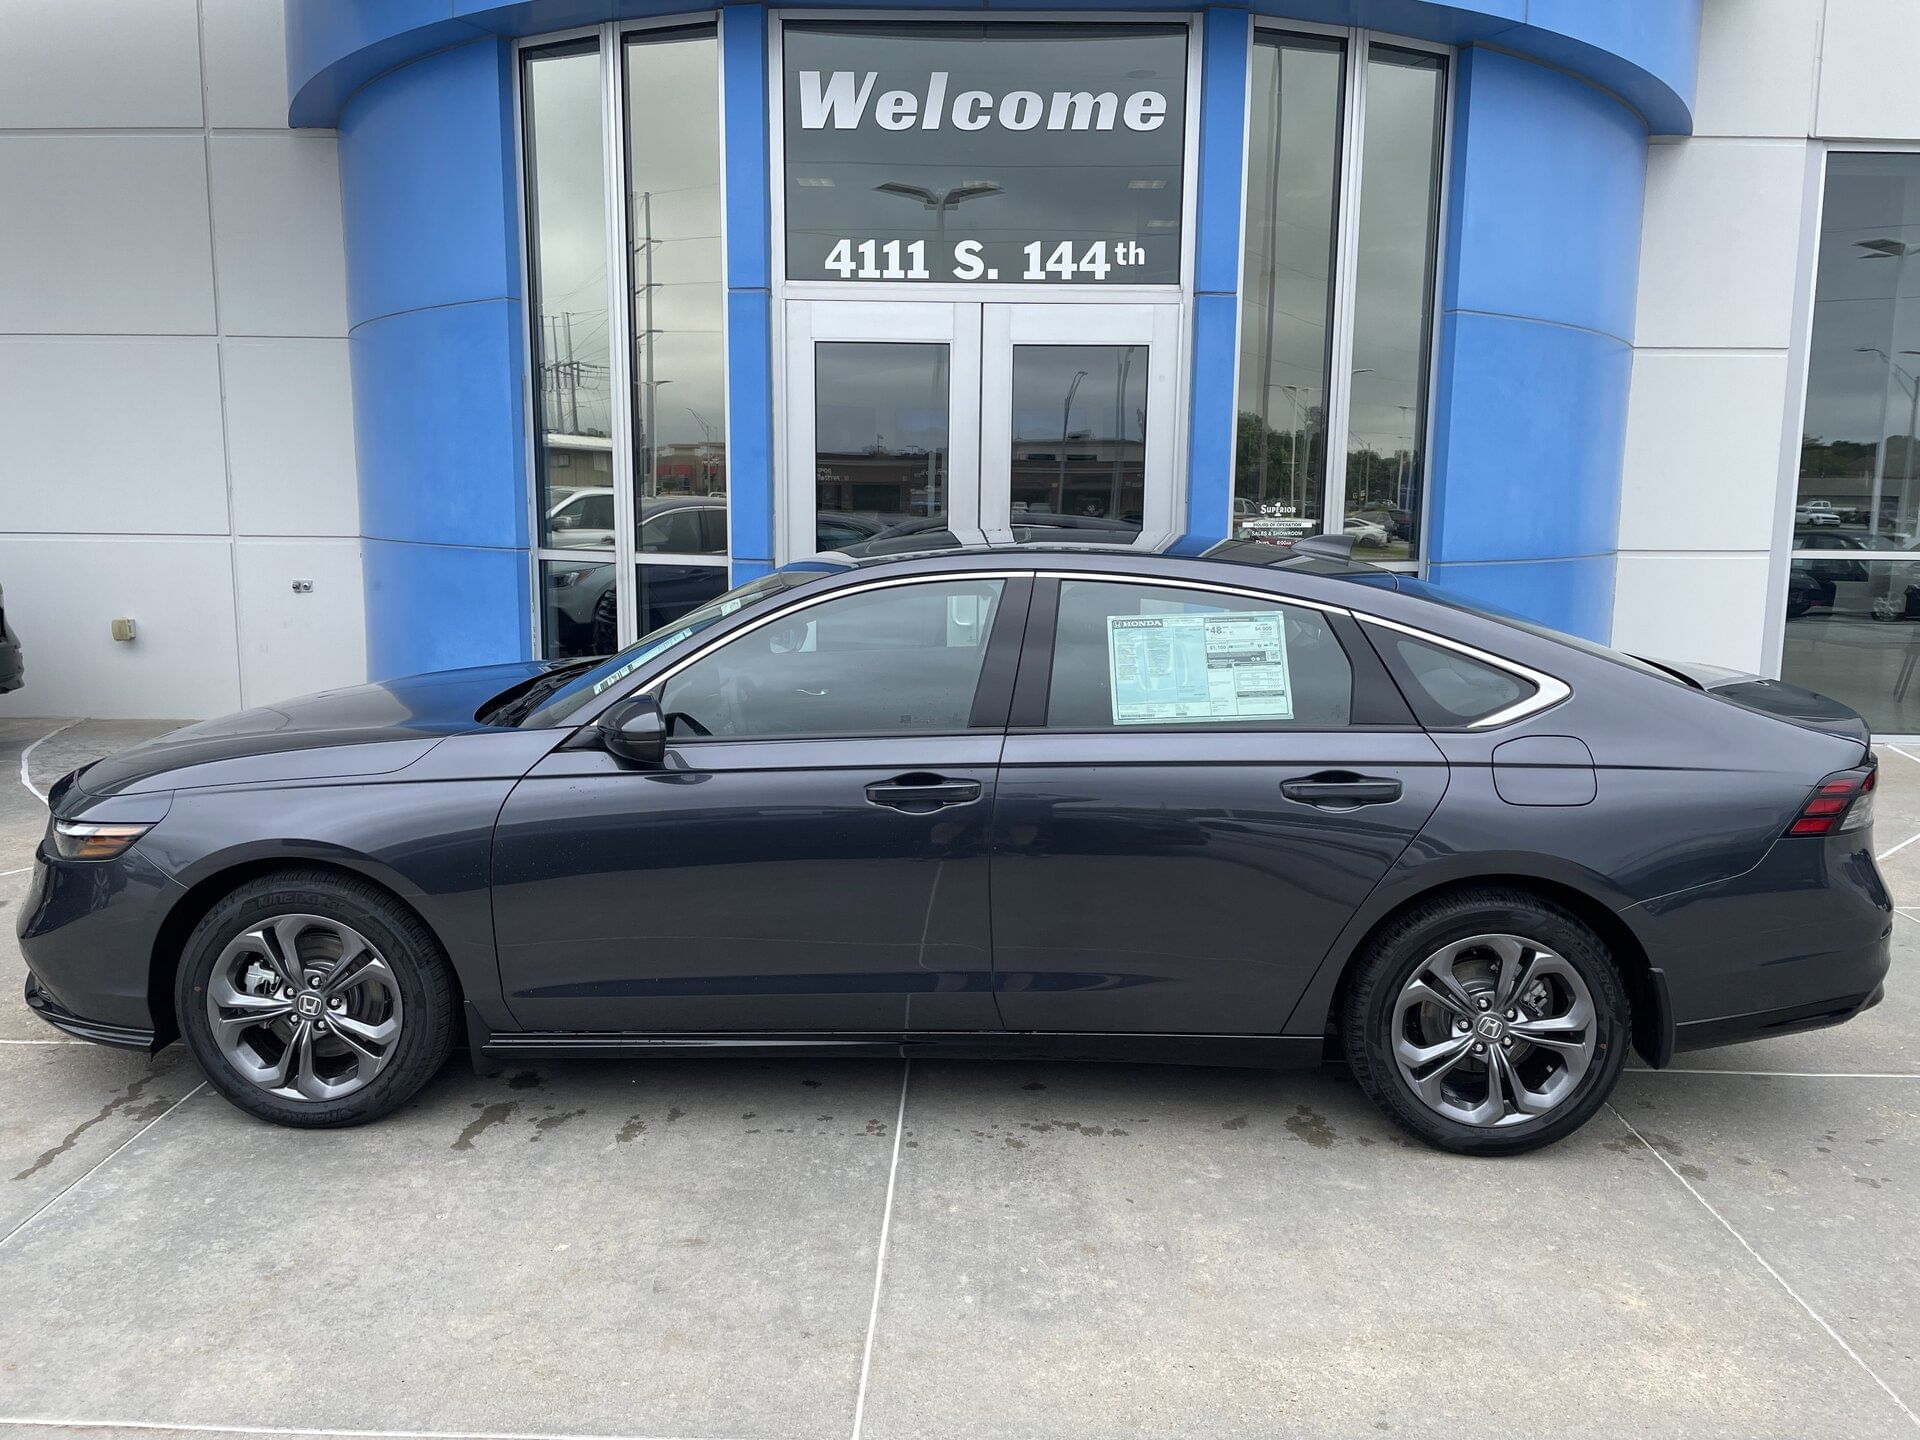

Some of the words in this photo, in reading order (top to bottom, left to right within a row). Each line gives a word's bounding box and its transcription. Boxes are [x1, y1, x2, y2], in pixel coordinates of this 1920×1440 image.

[799, 70, 1167, 131] Welcome
[824, 238, 930, 279] 4111
[952, 239, 999, 280] S.
[1123, 619, 1162, 627] HONDA
[1210, 626, 1222, 634] 48
